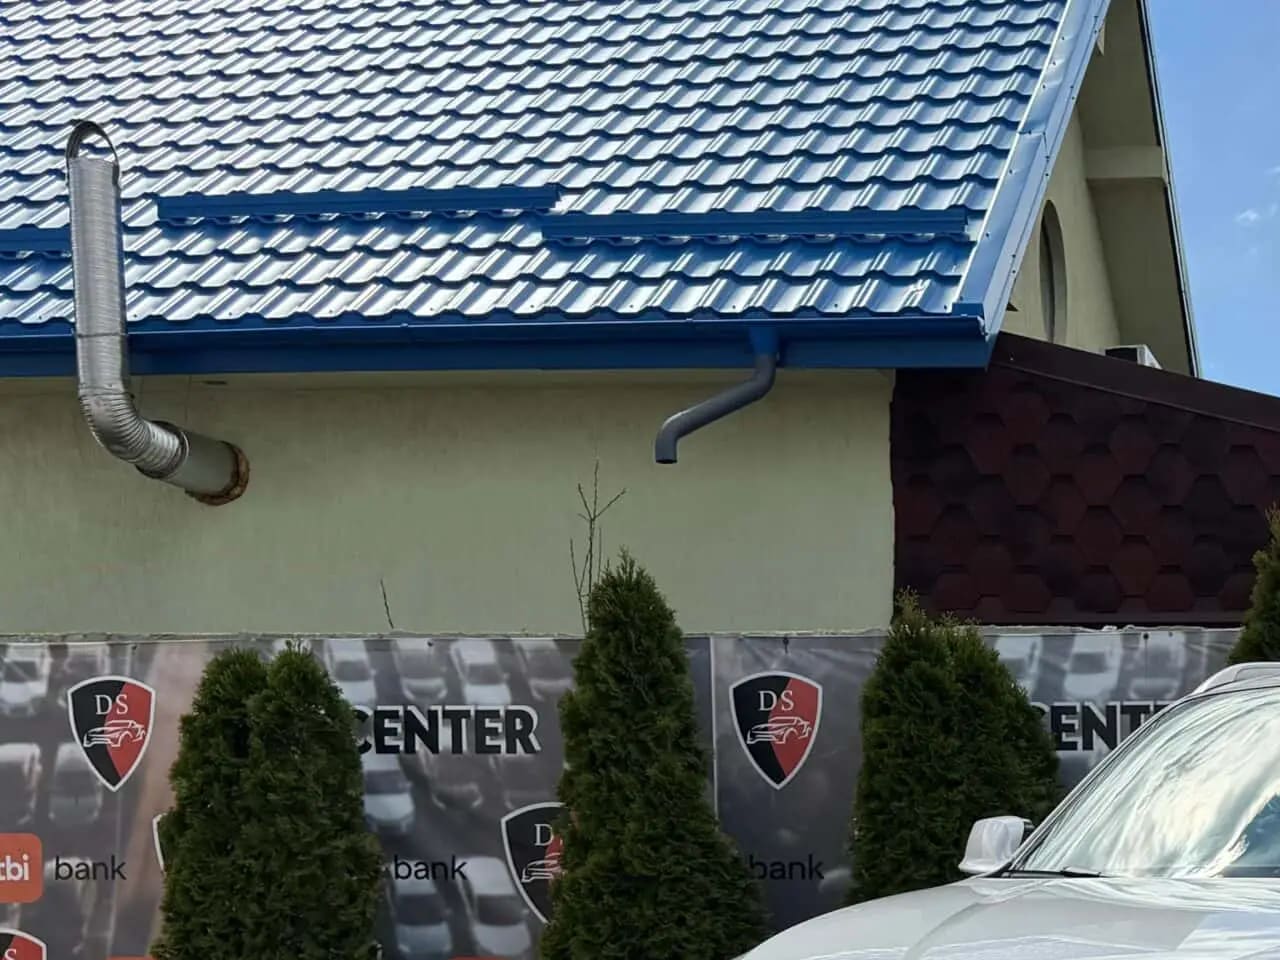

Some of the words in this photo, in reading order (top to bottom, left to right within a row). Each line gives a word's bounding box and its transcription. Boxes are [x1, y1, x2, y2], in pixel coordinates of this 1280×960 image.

[95, 694, 128, 715] DS
[757, 690, 795, 711] DS
[54, 856, 127, 881] bank
[394, 855, 468, 880] bank
[749, 853, 825, 880] bank
